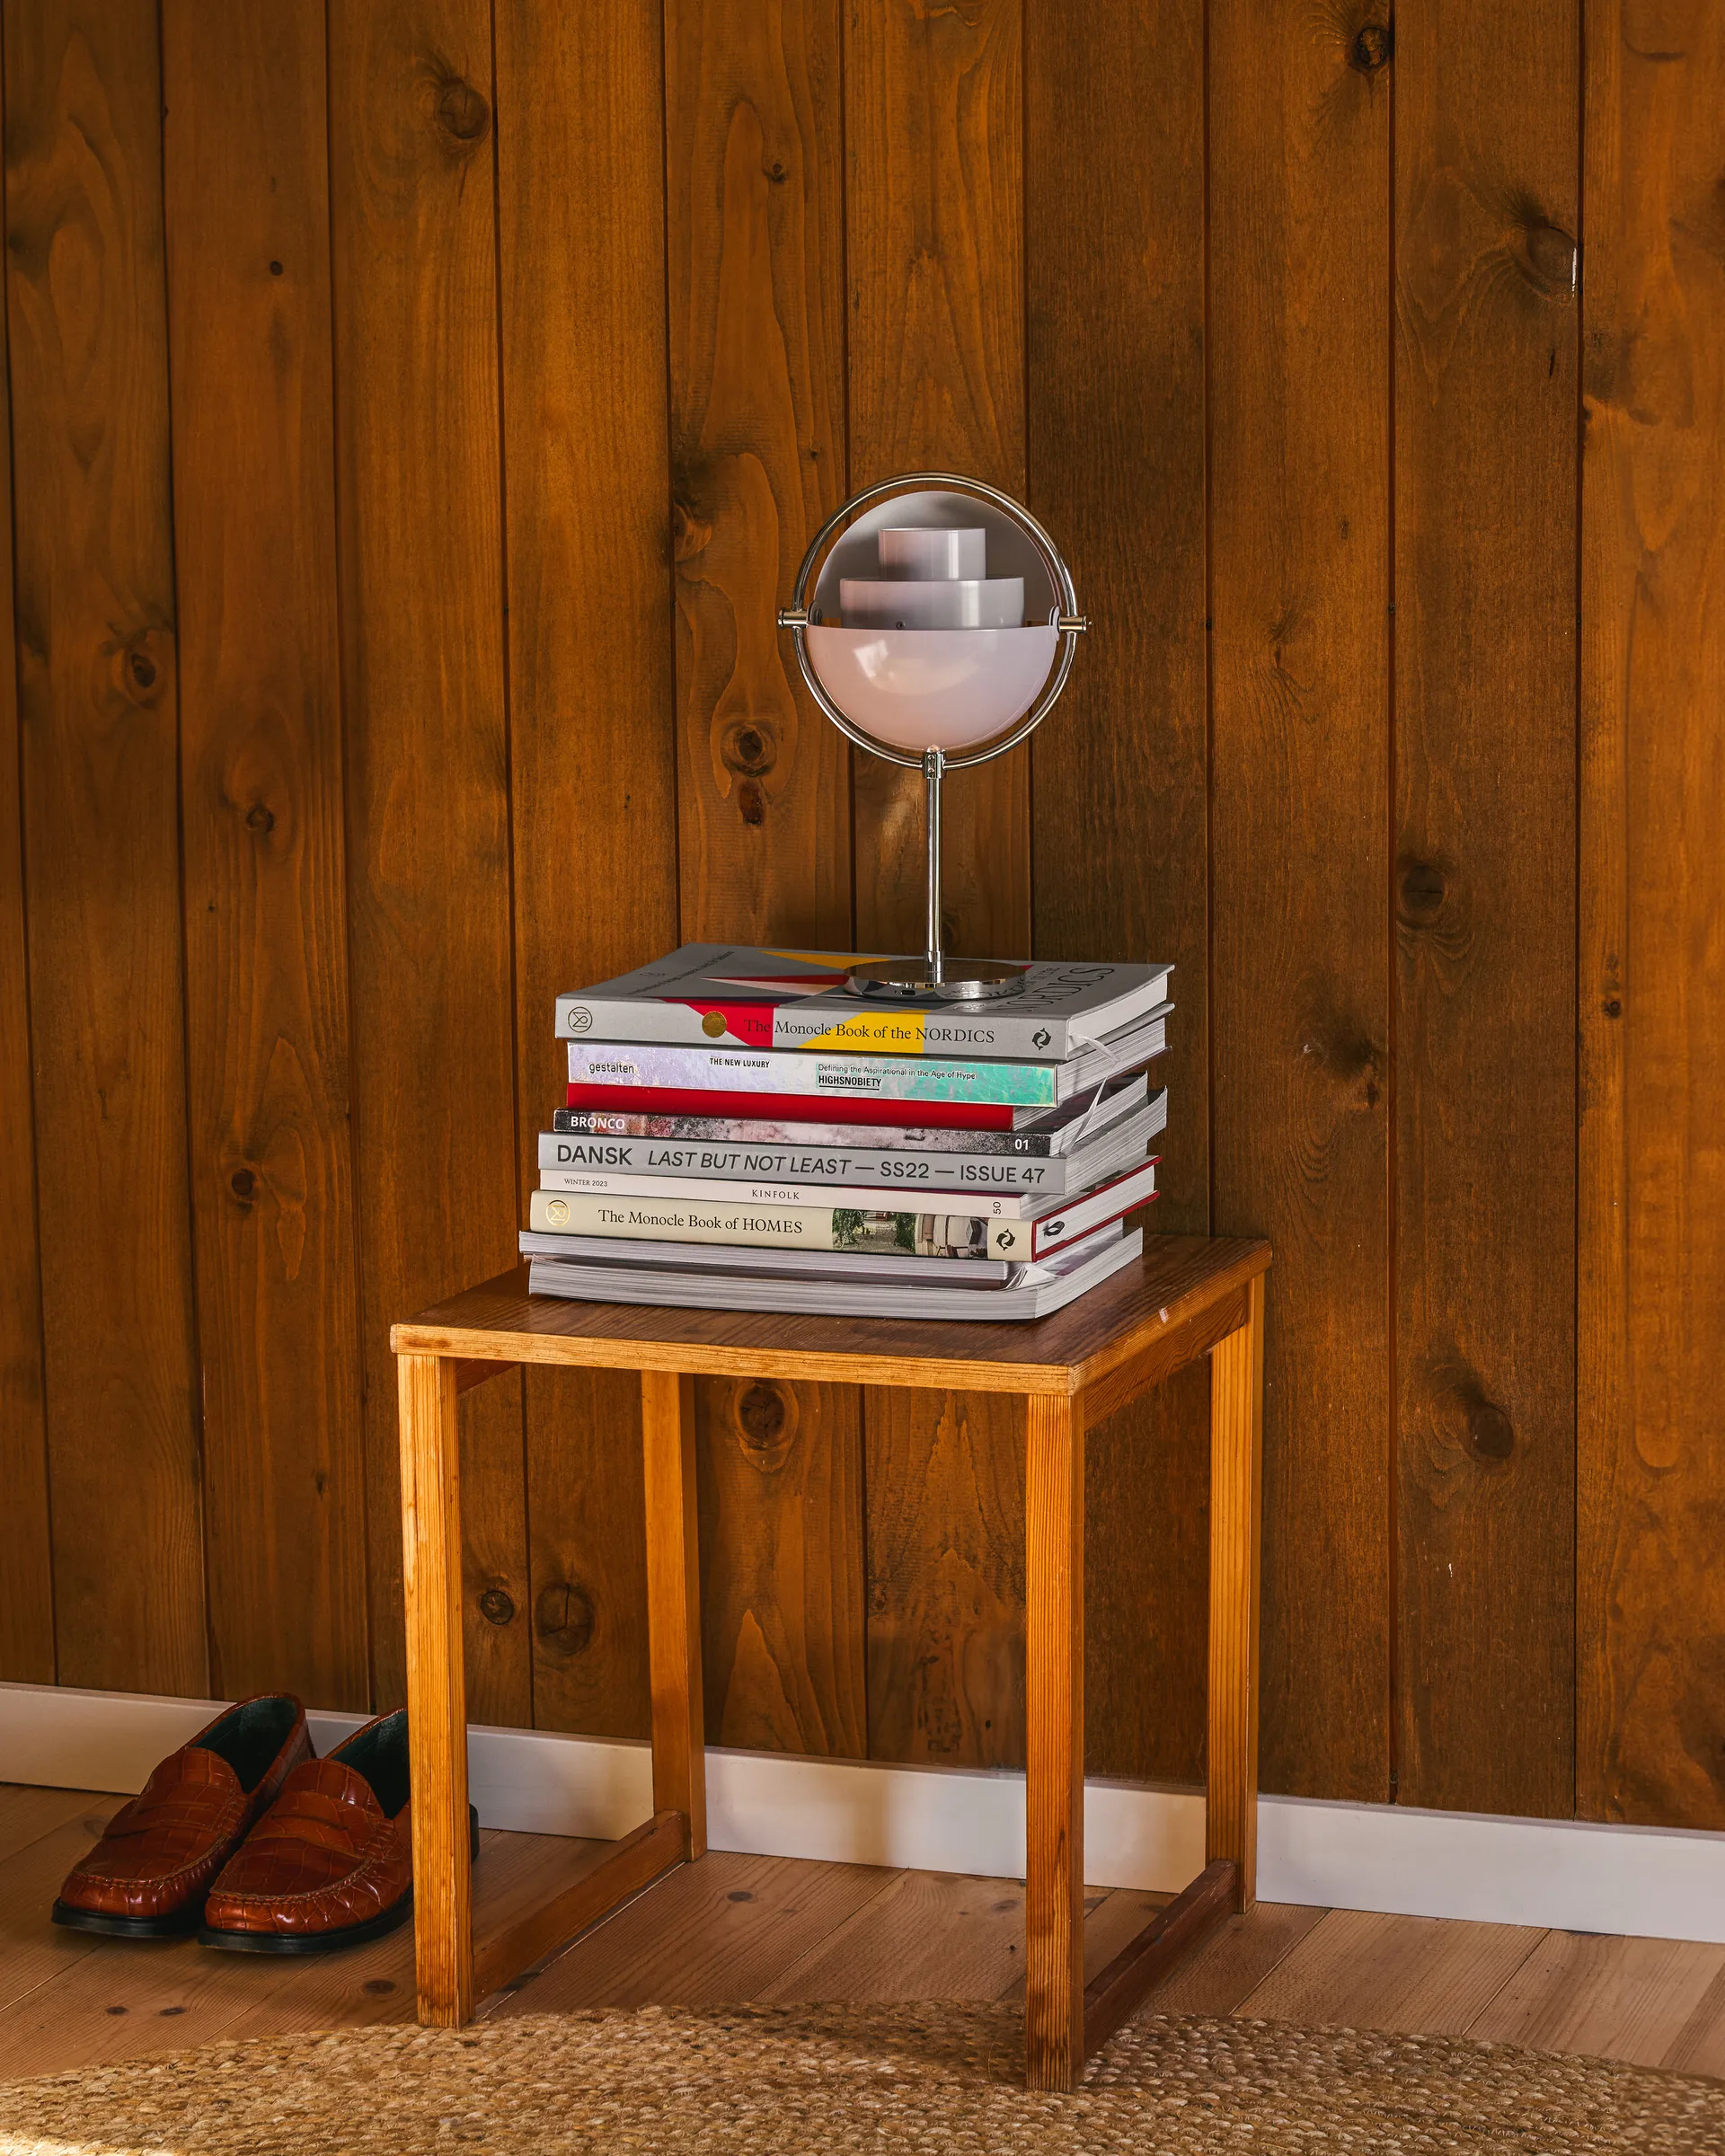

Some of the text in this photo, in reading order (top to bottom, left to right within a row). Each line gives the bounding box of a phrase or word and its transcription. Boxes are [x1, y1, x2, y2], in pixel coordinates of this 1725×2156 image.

[744, 1019, 995, 1043] The Monocle Book of the NORDICS
[588, 1062, 635, 1075] gestalten
[709, 1057, 770, 1068] THE NEW LUXURY
[818, 1064, 976, 1082] Defining the Aspirational in the Age of Hype
[818, 1075, 881, 1087] HIGHSNOBIETY
[570, 1116, 625, 1130] BRONCO
[1014, 1138, 1030, 1151] 01
[557, 1144, 632, 1166] DANSK
[647, 1150, 697, 1168] LAST
[701, 1153, 744, 1170] BUT
[744, 1154, 787, 1171] NOT
[790, 1157, 852, 1176] LEAST
[880, 1161, 930, 1179] SS22
[960, 1165, 1017, 1183] ISSUE
[1022, 1168, 1046, 1184] 47
[563, 1178, 608, 1188] WINTER 2023
[751, 1189, 801, 1200] KINFOLK
[993, 1201, 1002, 1215] 50
[597, 1208, 802, 1234] The Monocle Book of HOMES
